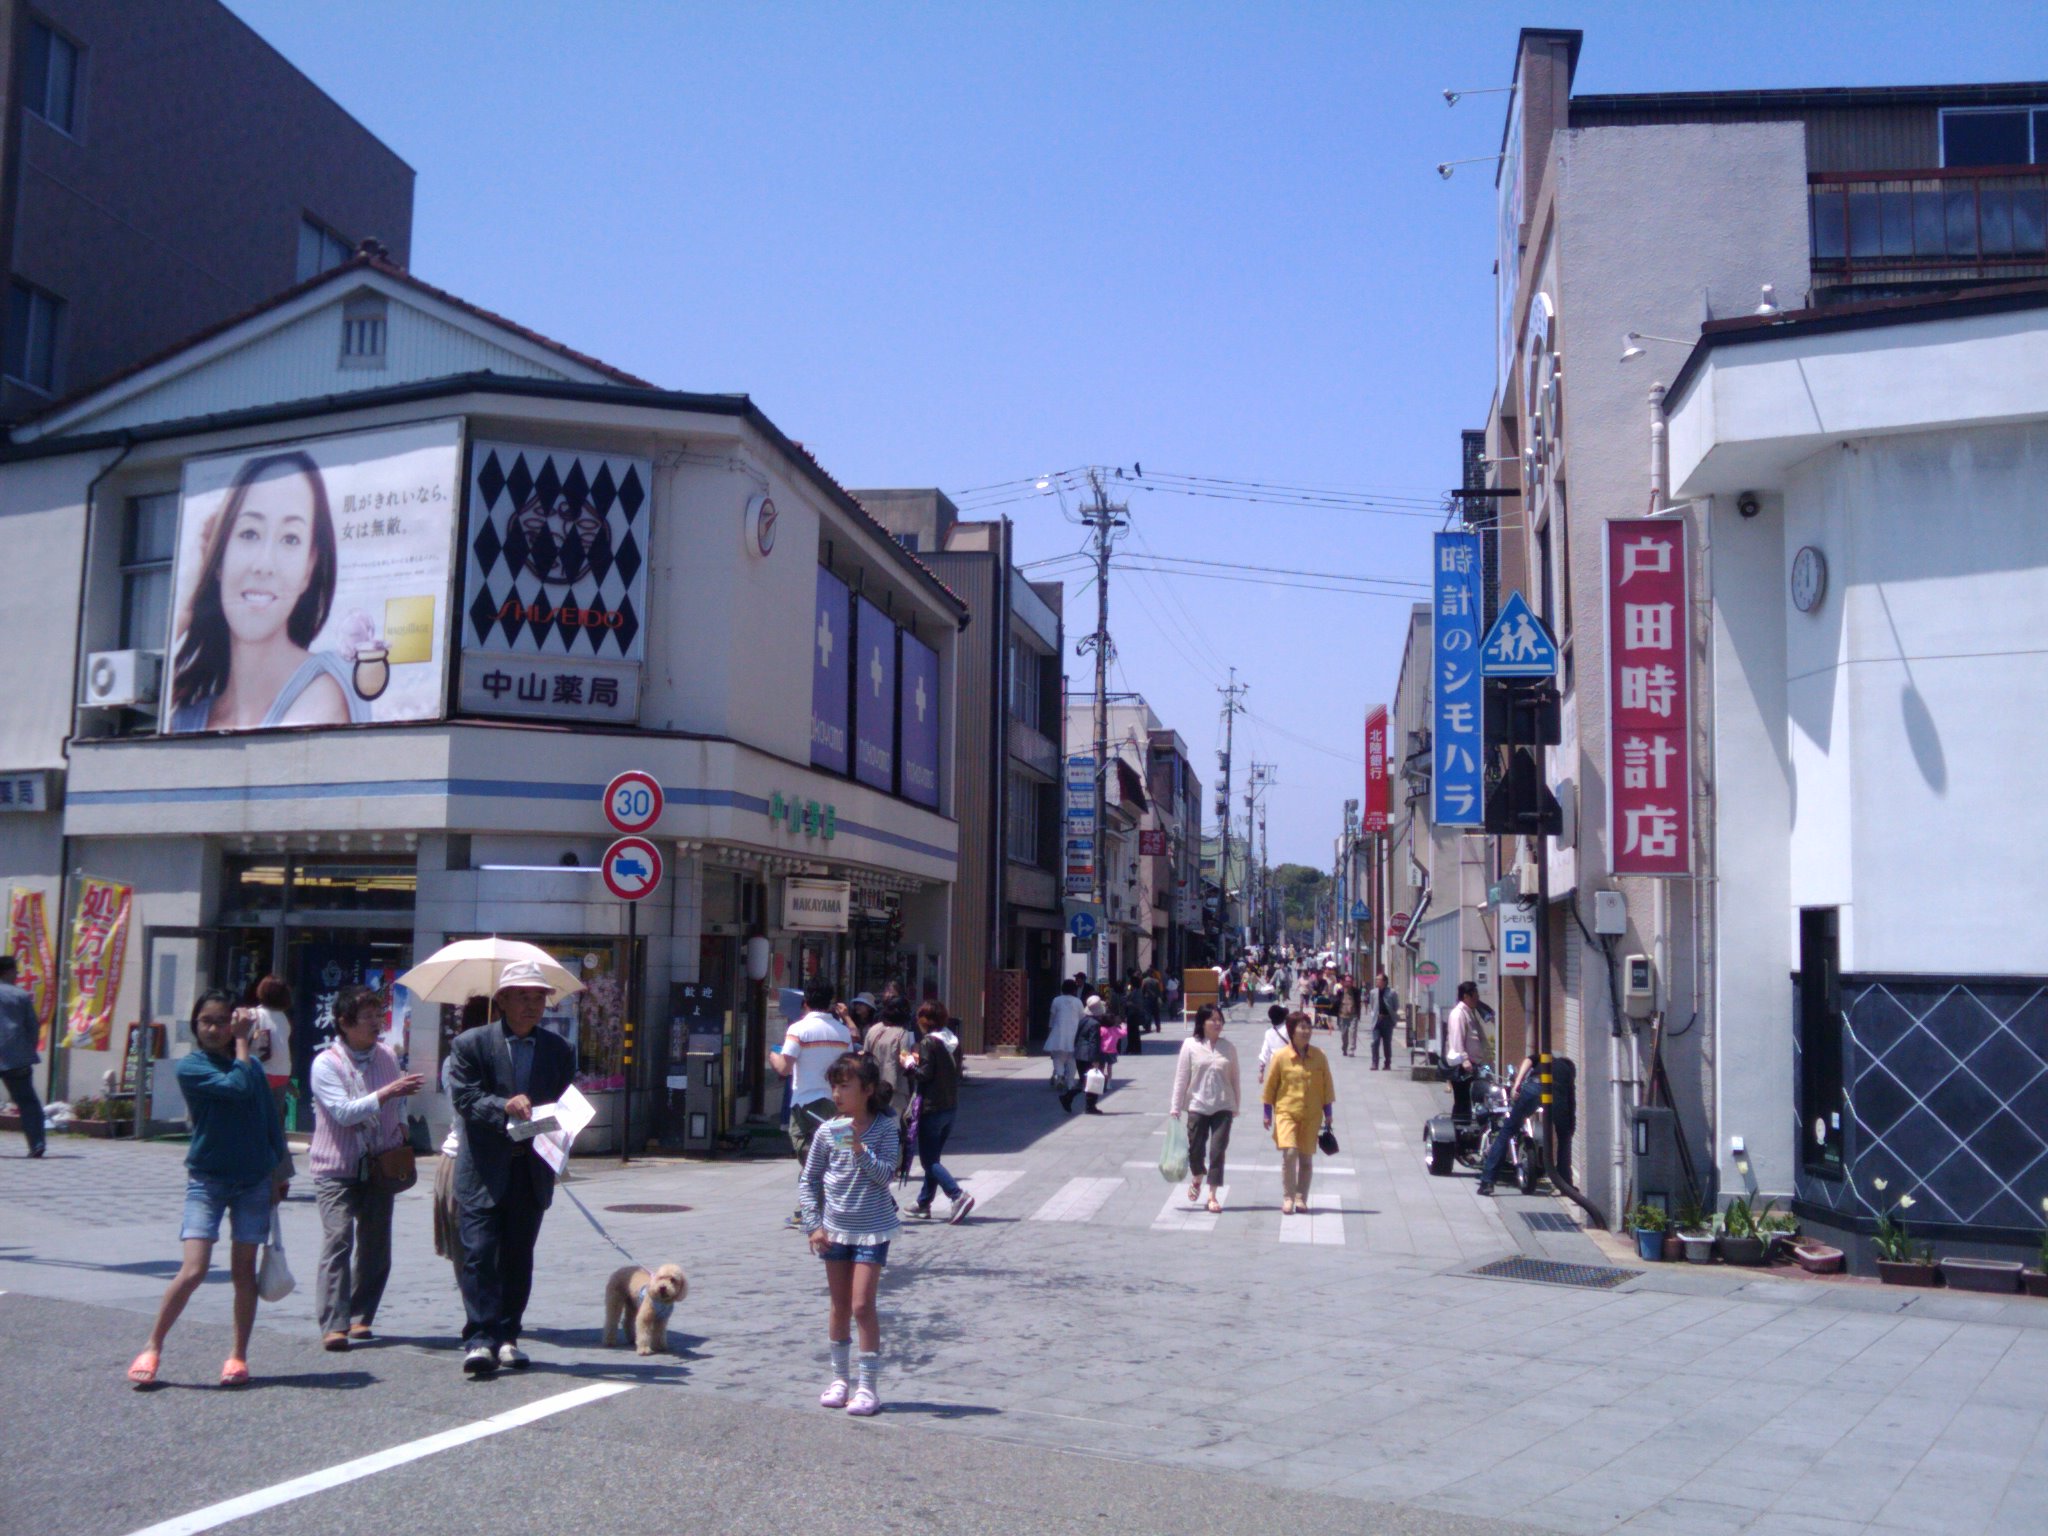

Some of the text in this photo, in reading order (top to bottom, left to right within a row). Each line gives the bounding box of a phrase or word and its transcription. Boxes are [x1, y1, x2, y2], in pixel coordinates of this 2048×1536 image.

[342, 484, 449, 514] 肌がきれいなら、
[341, 516, 408, 541] 女は無敵。
[487, 599, 625, 629] SHISEIDO
[481, 668, 619, 708] 中山薬局
[1440, 546, 1476, 816] 時計のシモハラ
[1369, 728, 1383, 780] 北陸銀行
[616, 789, 650, 816] 30
[792, 897, 842, 913] NAKAYAMA
[1503, 914, 1535, 924] シモハラ
[1511, 934, 1527, 951] P
[69, 884, 114, 1034] 処方せん
